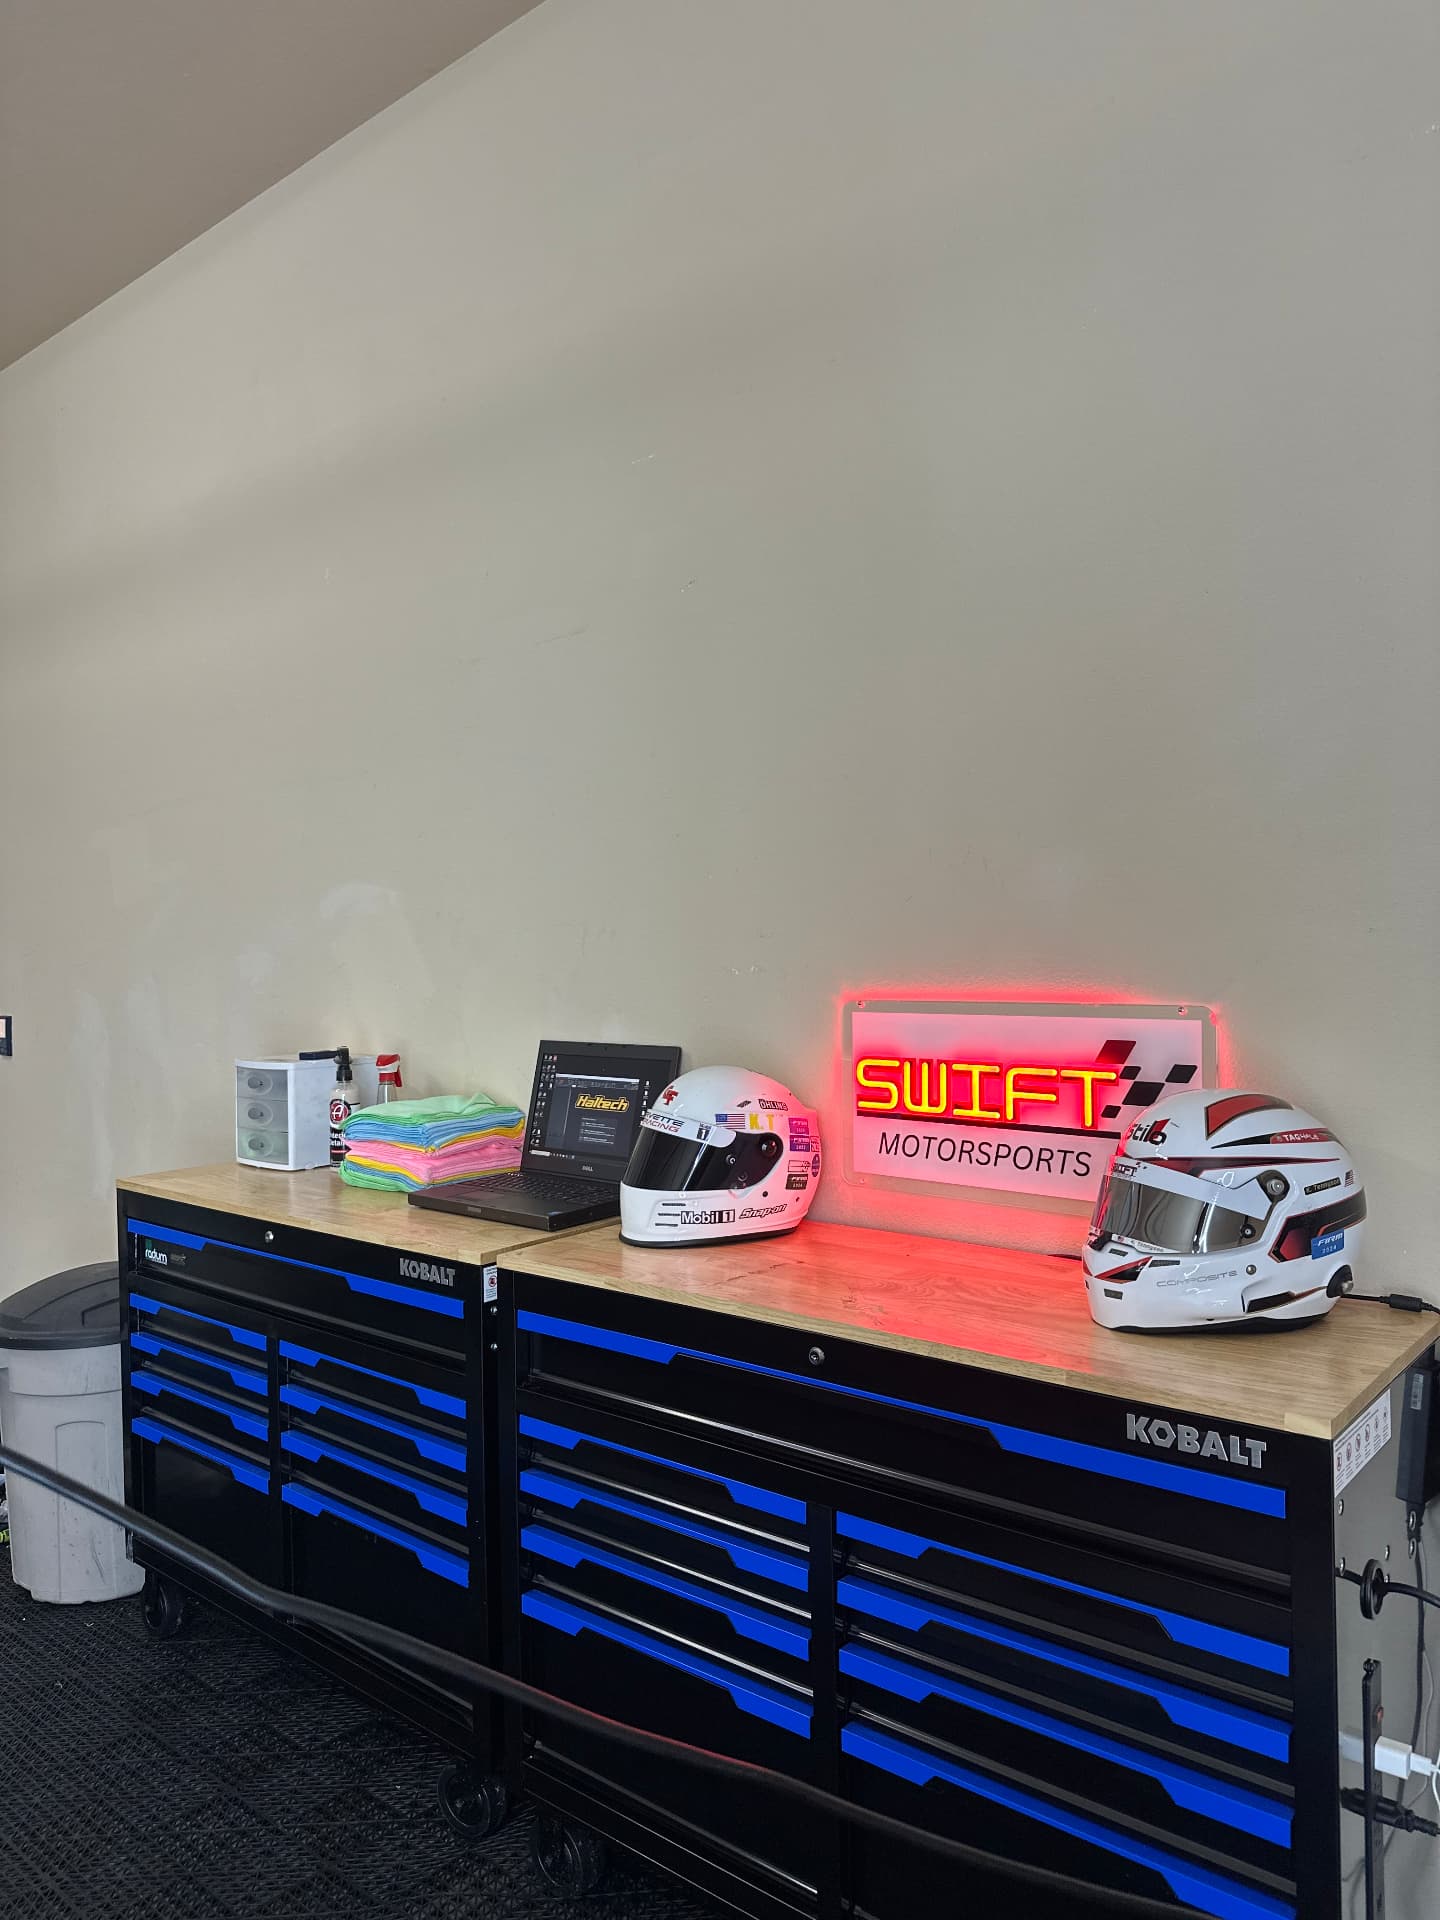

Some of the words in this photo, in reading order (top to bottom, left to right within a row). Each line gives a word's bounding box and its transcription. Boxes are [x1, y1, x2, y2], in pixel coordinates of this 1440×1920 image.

[575, 1093, 629, 1112] Haltech
[856, 1058, 1118, 1128] SWIFT
[641, 1120, 681, 1133] RACING
[878, 1131, 1092, 1177] MOTORSPORTS
[681, 1211, 719, 1224] Mobil
[739, 1204, 787, 1219] Snap-on
[399, 1257, 456, 1288] KOBALT
[1156, 1270, 1238, 1288] COMPOSITE
[1126, 1412, 1267, 1469] KOBALT
